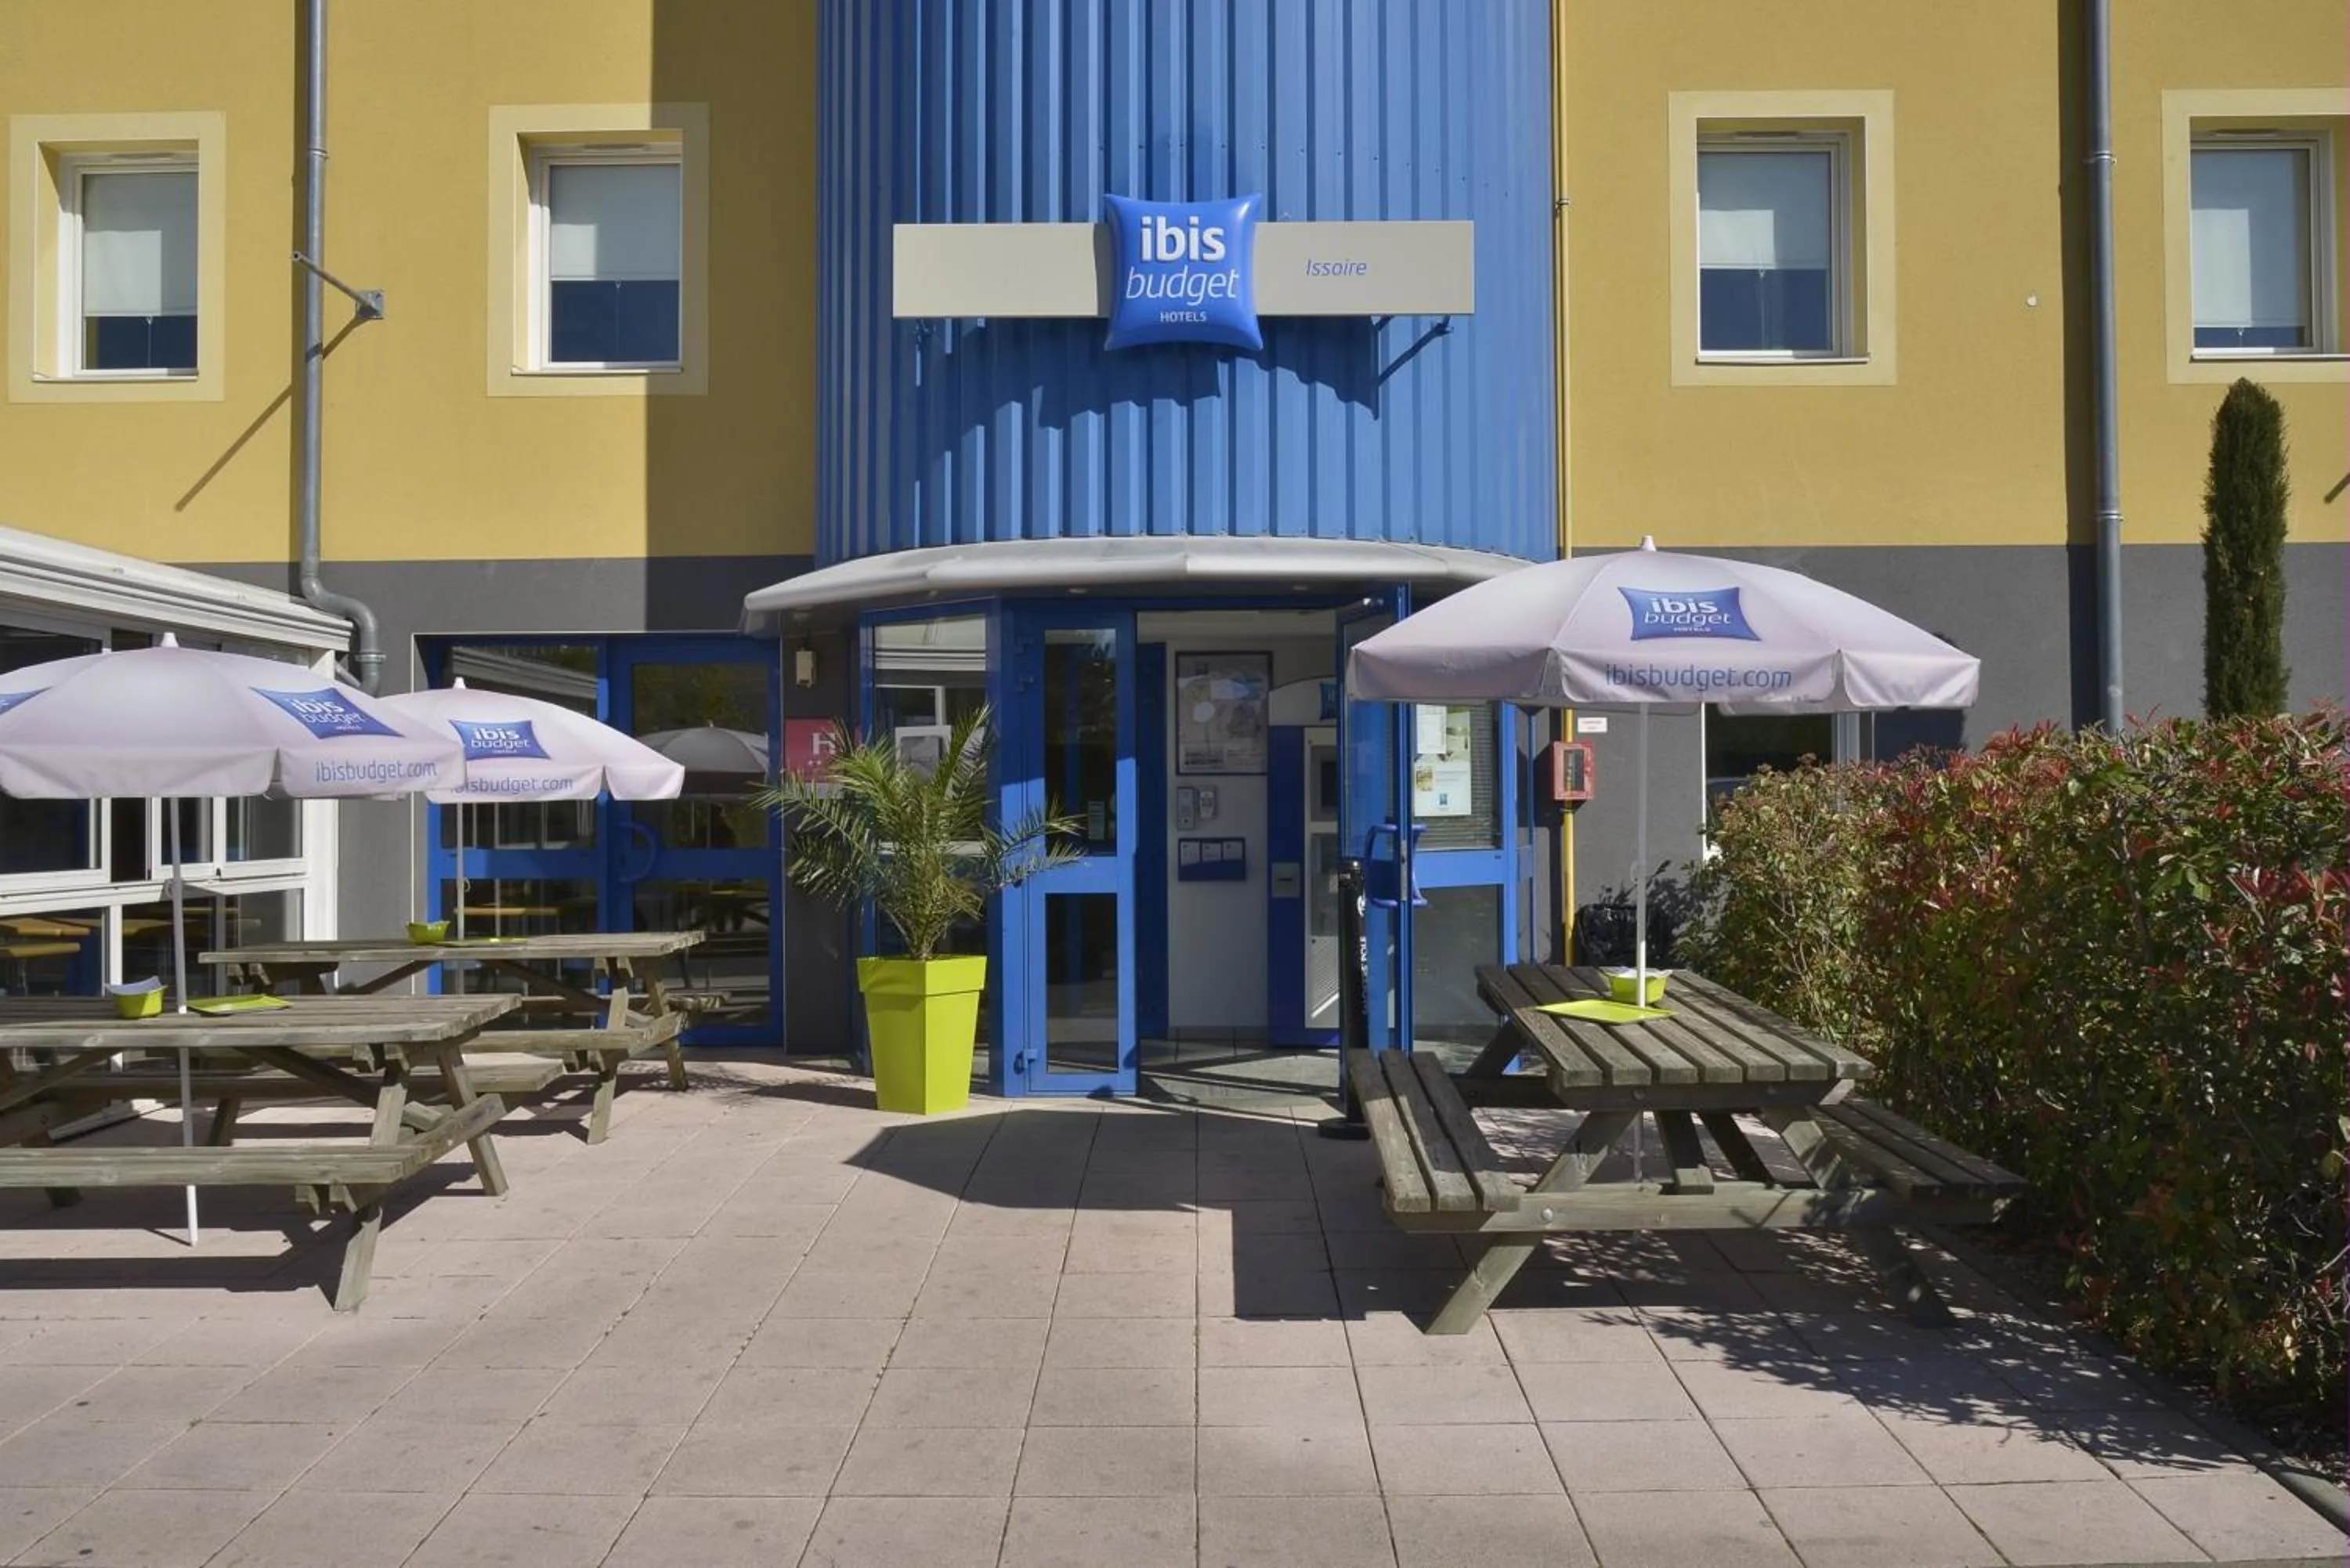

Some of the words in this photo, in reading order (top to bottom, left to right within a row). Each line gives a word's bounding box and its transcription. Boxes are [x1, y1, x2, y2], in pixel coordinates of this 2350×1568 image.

[1141, 215, 1226, 262] ibis
[1306, 259, 1368, 277] Issoire
[1126, 265, 1240, 306] budget
[1159, 311, 1207, 323] HOTELS
[1652, 597, 1718, 614] ibis
[1645, 610, 1731, 626] budget
[1606, 663, 1791, 692] ibisbudget.com
[290, 699, 345, 714] ibis
[300, 712, 366, 725] budget
[474, 728, 520, 740] ibis
[471, 739, 530, 749] budget
[316, 759, 437, 783] ibisbudget.com
[451, 775, 573, 795] isbudget.com
